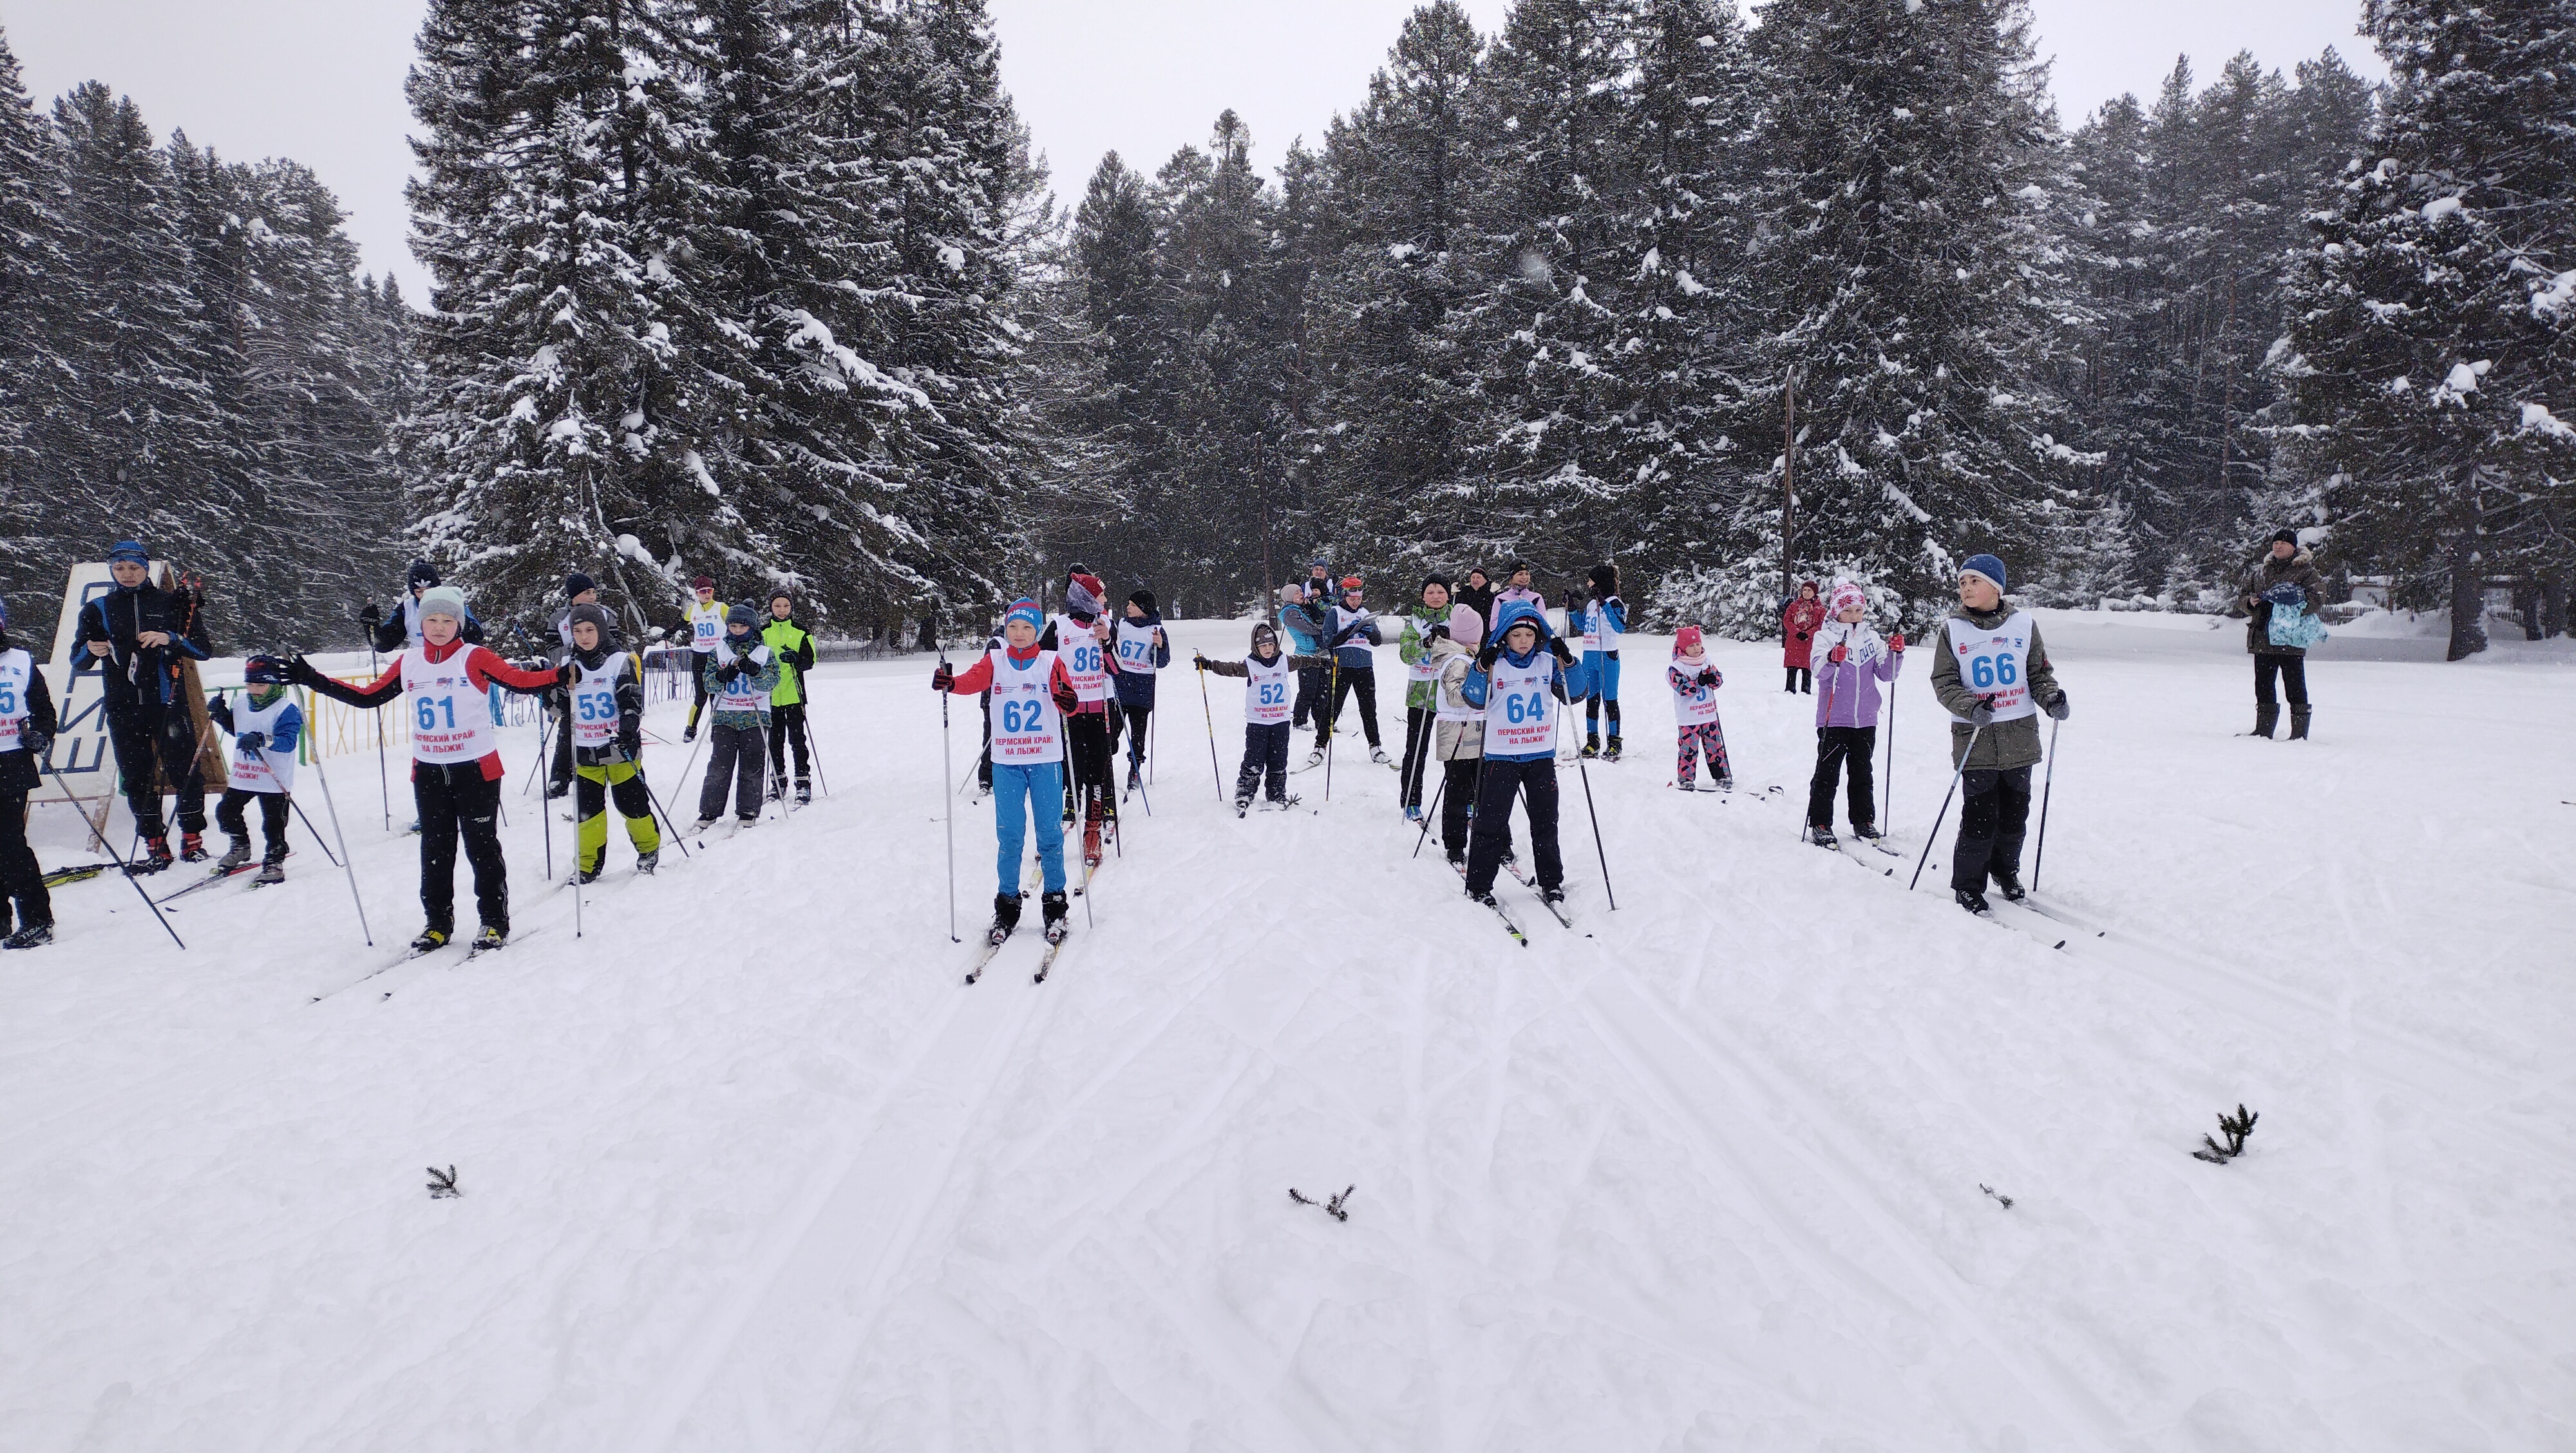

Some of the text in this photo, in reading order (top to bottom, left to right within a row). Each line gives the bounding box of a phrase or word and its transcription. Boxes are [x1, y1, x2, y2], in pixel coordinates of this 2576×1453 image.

[697, 623, 714, 636] 60
[1121, 640, 1145, 660] 67
[1074, 647, 1100, 672] 86
[1972, 653, 2016, 687] 66
[1260, 683, 1284, 704] 52
[417, 696, 455, 730] 61
[578, 692, 615, 720] 53
[1507, 692, 1544, 723] 64
[1004, 700, 1042, 732] 62
[575, 722, 608, 730] ЕРМСКИЙ
[1497, 726, 1535, 736] ПЕРМСКИЙ
[452, 730, 475, 741] КРАЙ!
[995, 735, 1053, 745] ПЕРМСКИЙ КРАЙ!
[1520, 735, 1545, 744] ЛЫЖИ!
[421, 743, 464, 753] НА ЛЫЖИ!
[1017, 746, 1042, 755] ЛЫЖИ!
